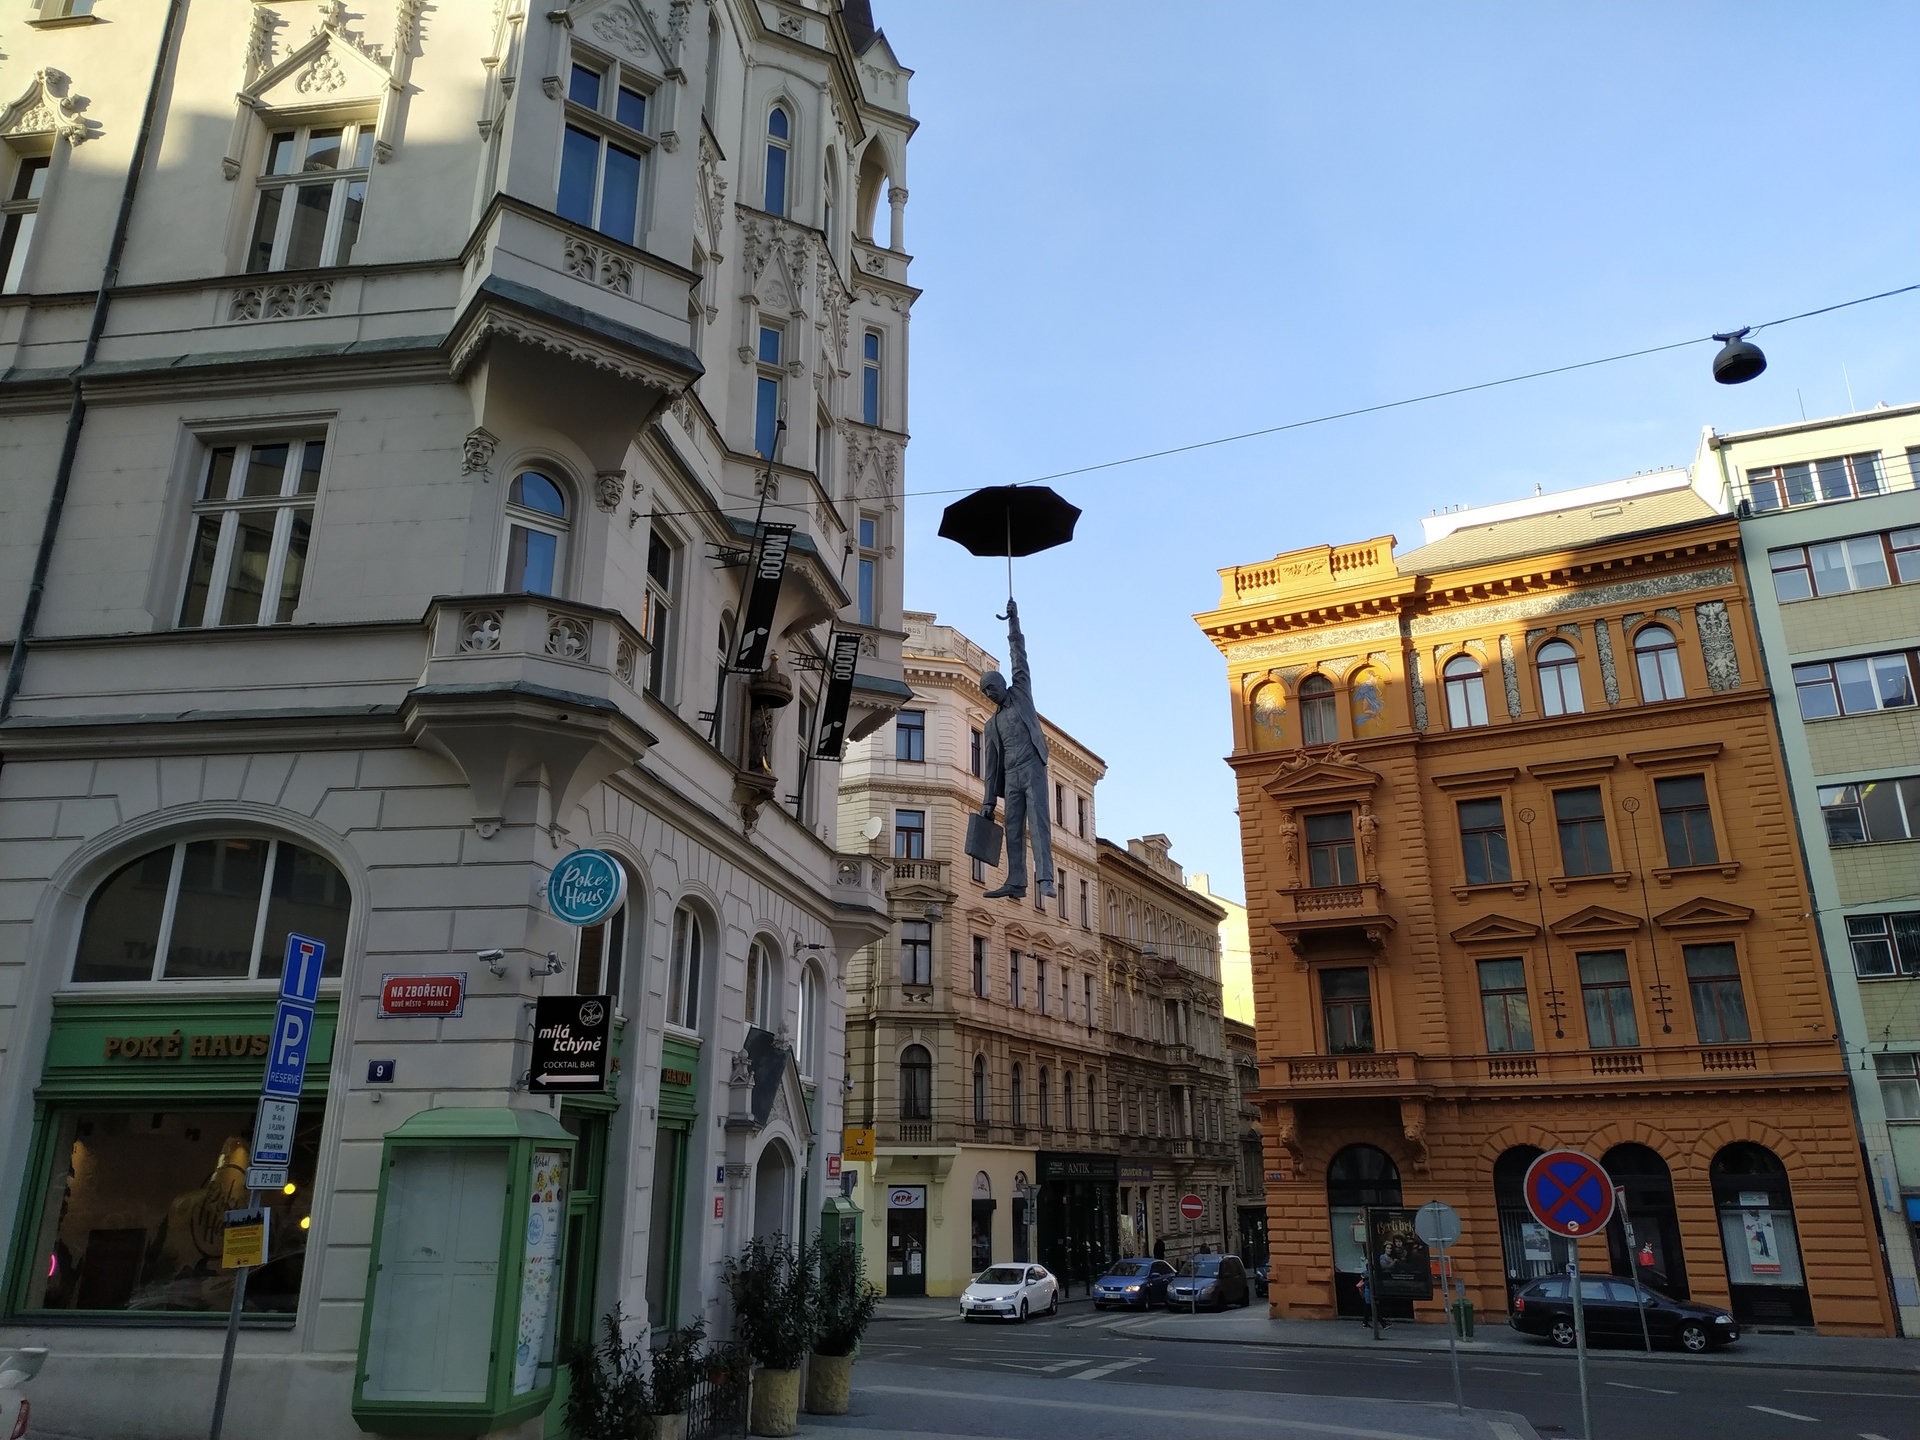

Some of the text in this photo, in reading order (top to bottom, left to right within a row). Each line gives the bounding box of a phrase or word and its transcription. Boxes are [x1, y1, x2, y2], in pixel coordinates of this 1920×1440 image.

[564, 886, 605, 910] Haus
[391, 984, 453, 998] NA ZBOŘENCI
[278, 1013, 304, 1065] P
[538, 1024, 570, 1039] milá
[104, 1028, 270, 1058] POKÉ HAUS
[552, 1036, 602, 1055] tchýně
[376, 1065, 384, 1077] 9
[543, 1060, 596, 1069] COCKTAIL BAR
[270, 1070, 301, 1085] RÉSERVÉ
[1067, 1163, 1090, 1174] ANTIK
